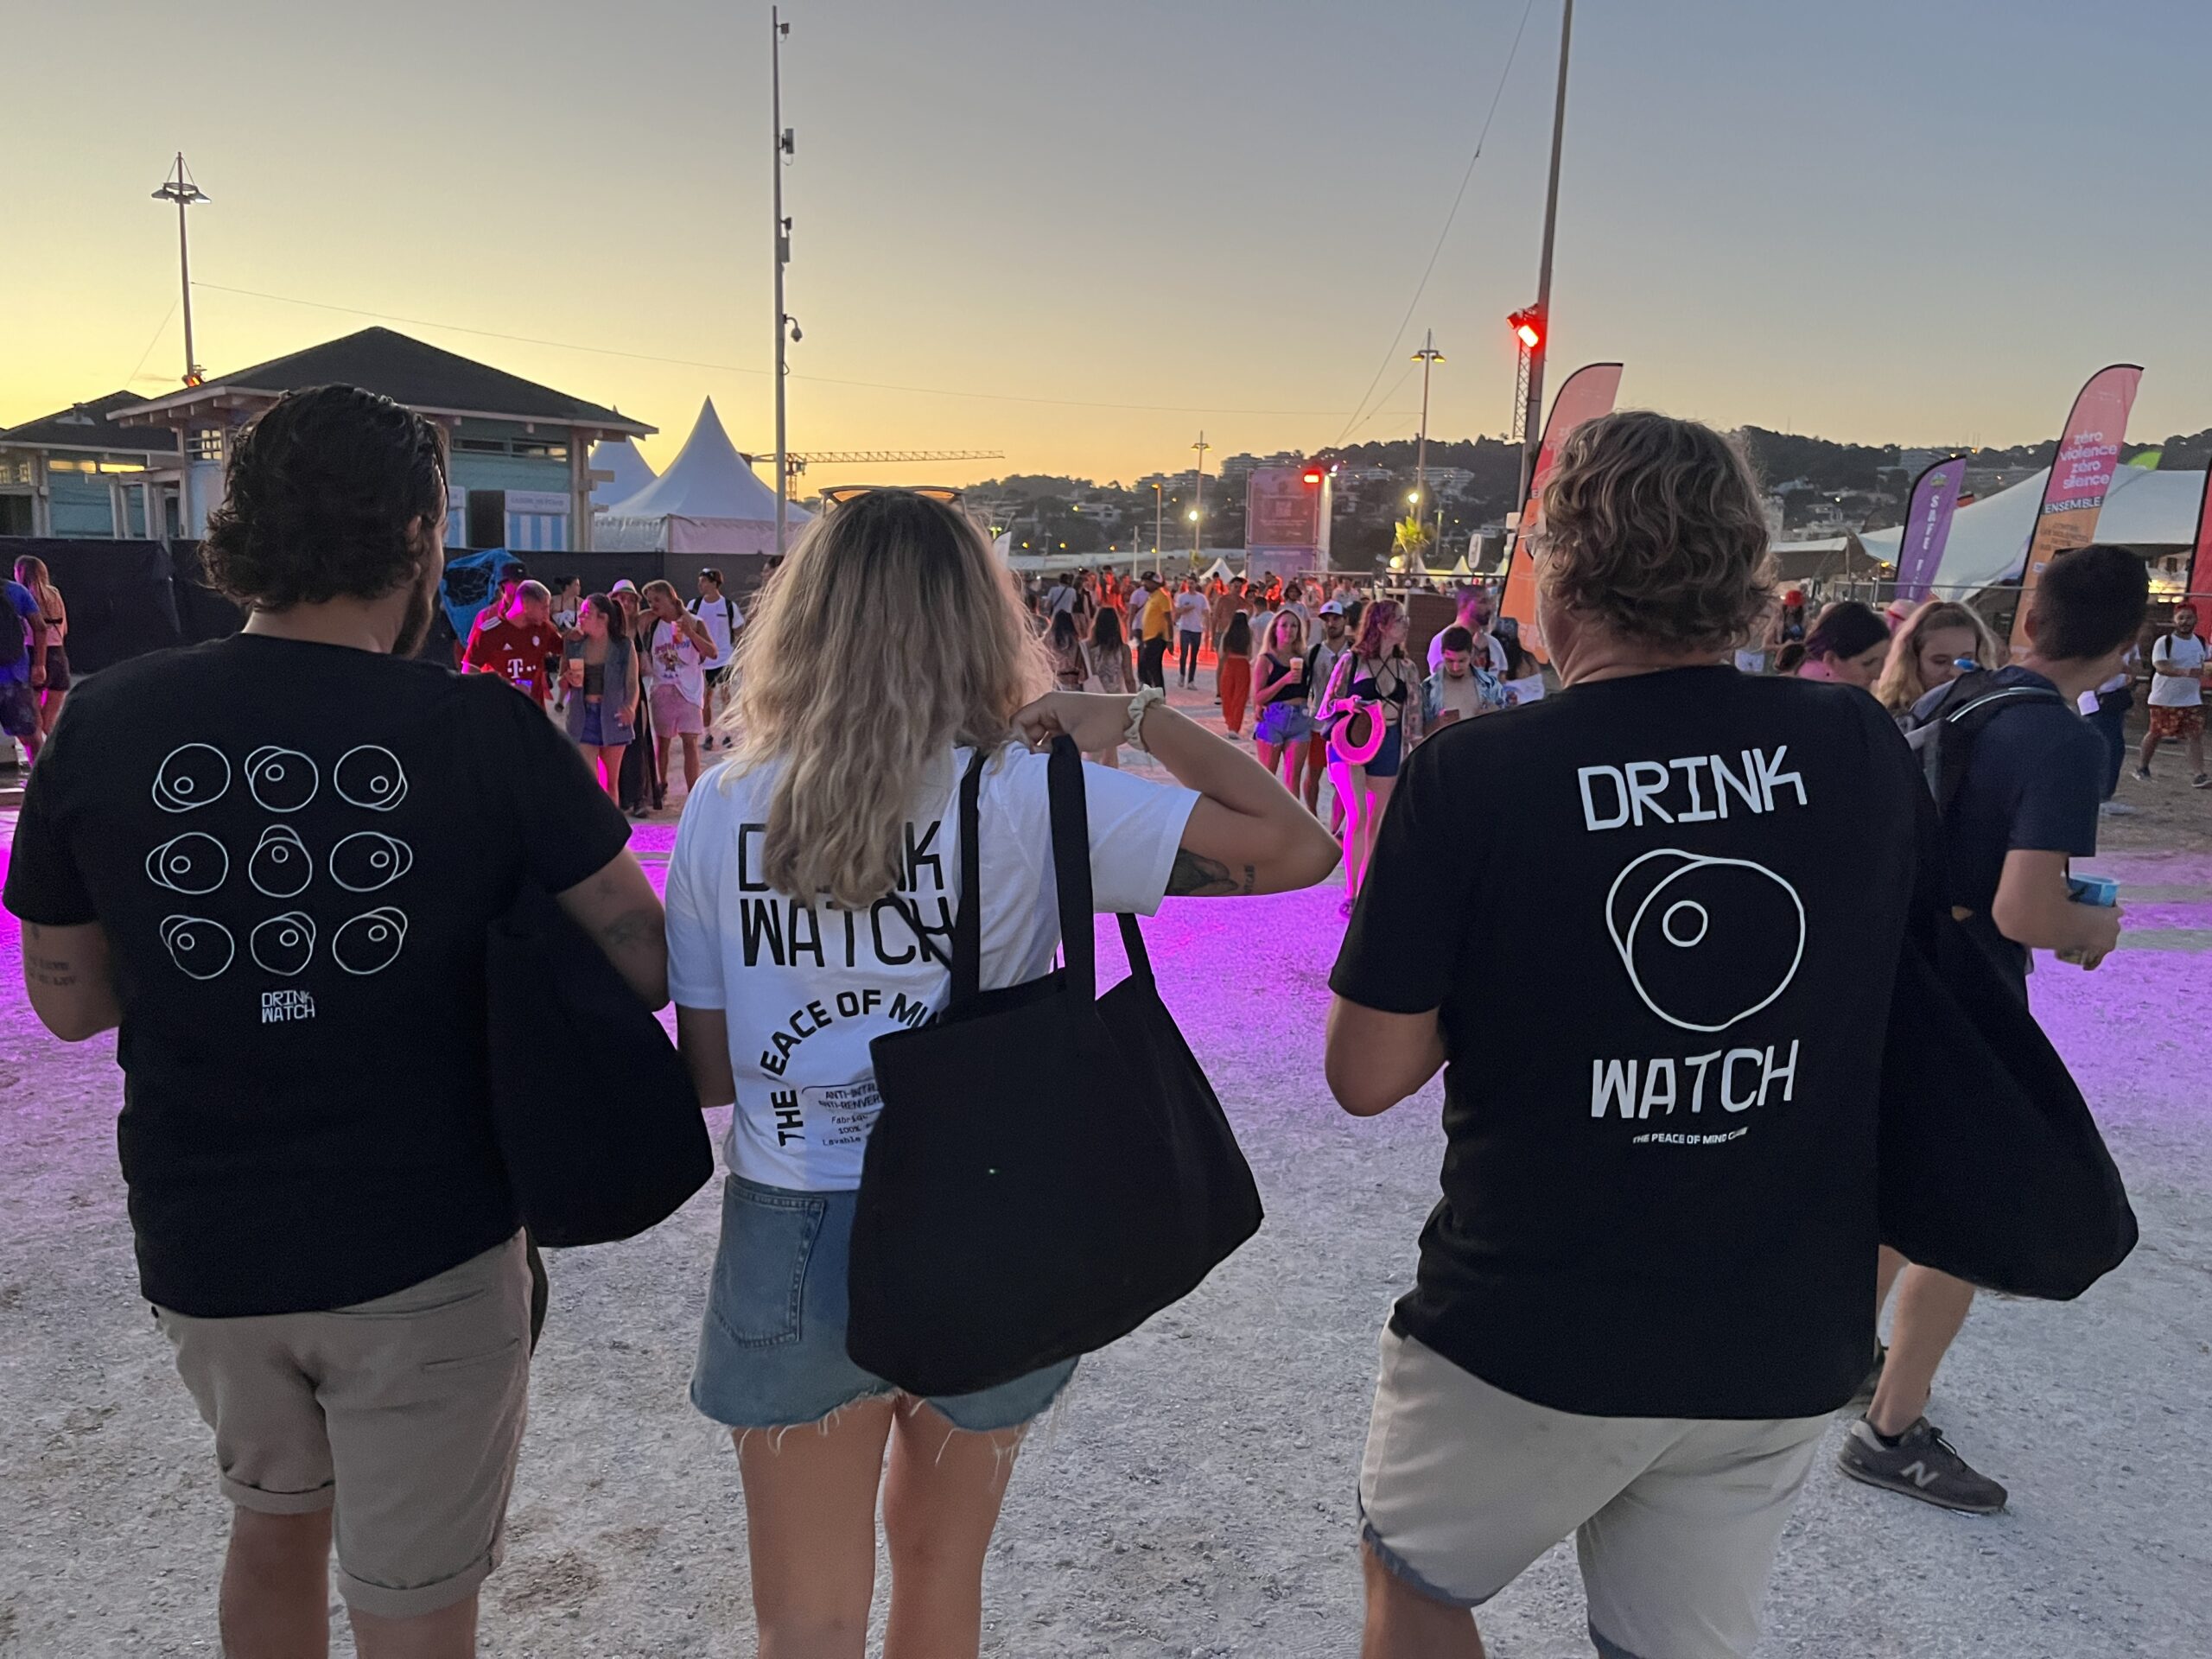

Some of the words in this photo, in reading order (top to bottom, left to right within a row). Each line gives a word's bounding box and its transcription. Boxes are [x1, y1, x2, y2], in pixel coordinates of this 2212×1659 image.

[2060, 445, 2117, 461] violence
[2044, 496, 2101, 514] ENSEMBLE
[1923, 495, 1940, 550] SAFE
[1578, 745, 1808, 831] DRINK
[741, 896, 959, 968] WATCH
[261, 990, 314, 1007] DRINK
[261, 1004, 316, 1023] WATCH
[770, 1089, 805, 1147] THE
[836, 988, 881, 1018] OF
[1591, 1039, 1800, 1120] WATCH
[838, 1126, 861, 1135] 100%
[1632, 1133, 1649, 1144] THE
[1651, 1133, 1685, 1144] PEACE
[1687, 1135, 1701, 1144] OF
[1702, 1133, 1727, 1145] MIND
[1901, 1460, 1941, 1488] N
